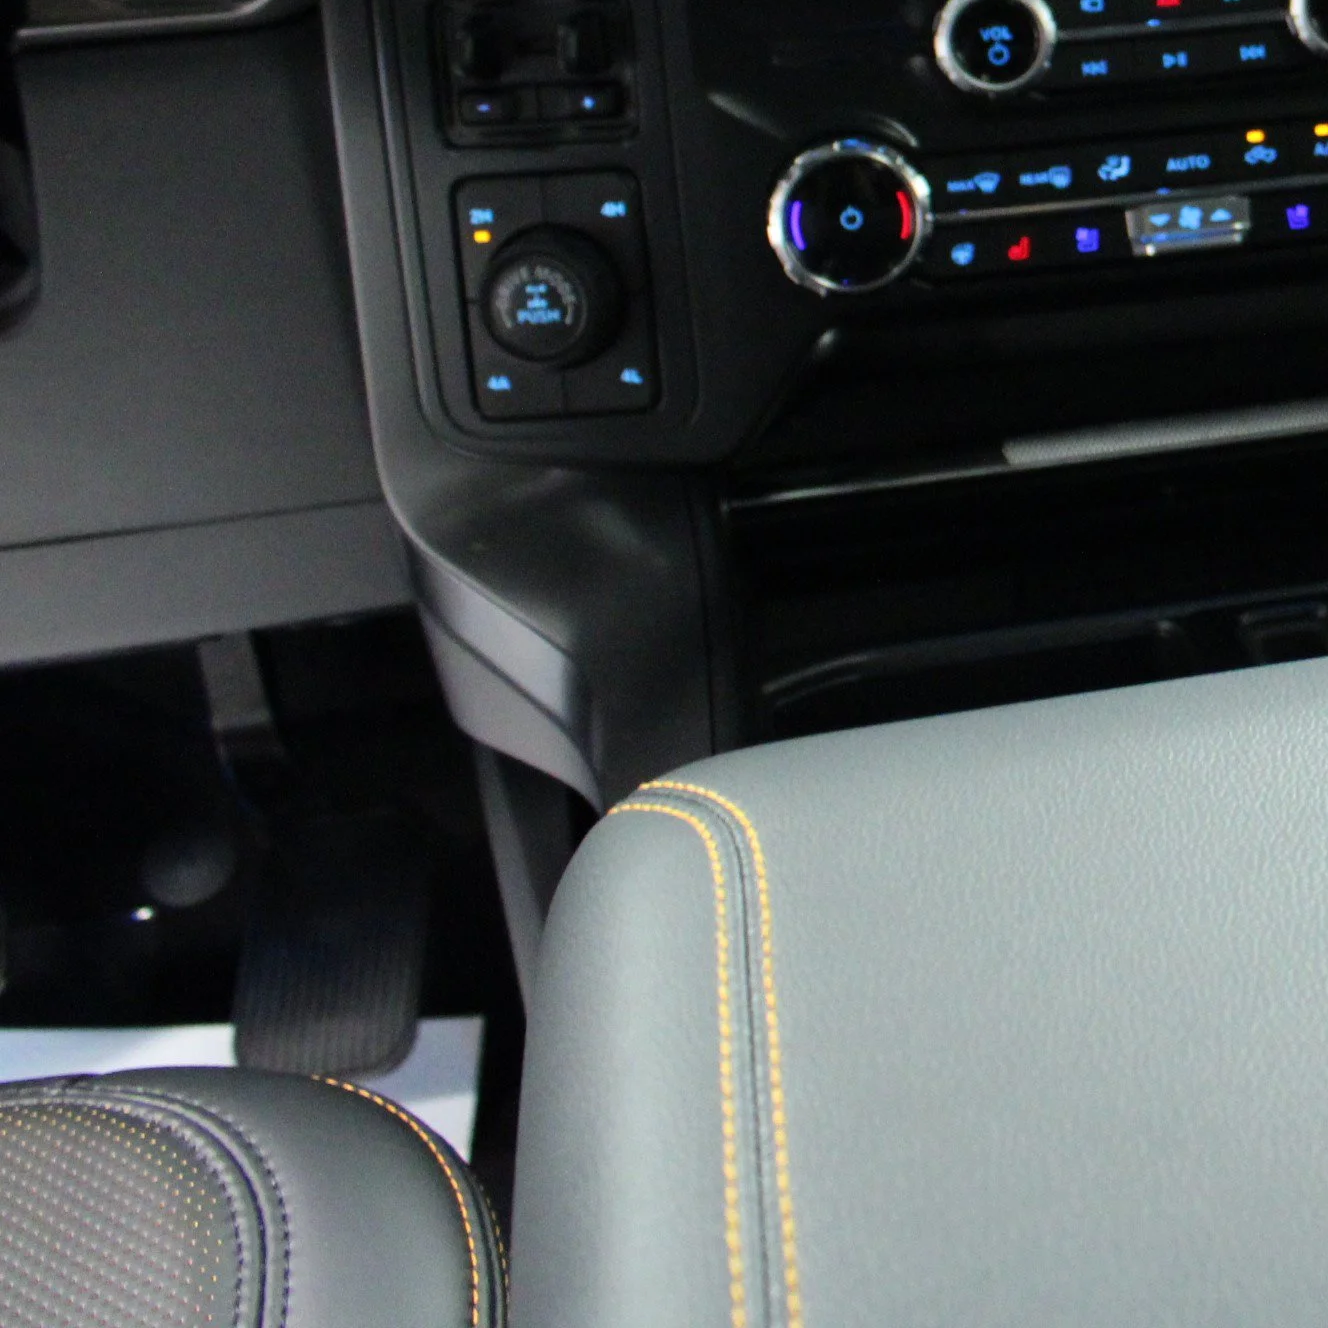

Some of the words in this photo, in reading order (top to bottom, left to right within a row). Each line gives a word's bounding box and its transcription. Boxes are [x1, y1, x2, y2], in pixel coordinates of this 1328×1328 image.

[980, 26, 1013, 41] VOL
[1166, 154, 1211, 172] AUTO
[517, 308, 562, 324] PUSH
